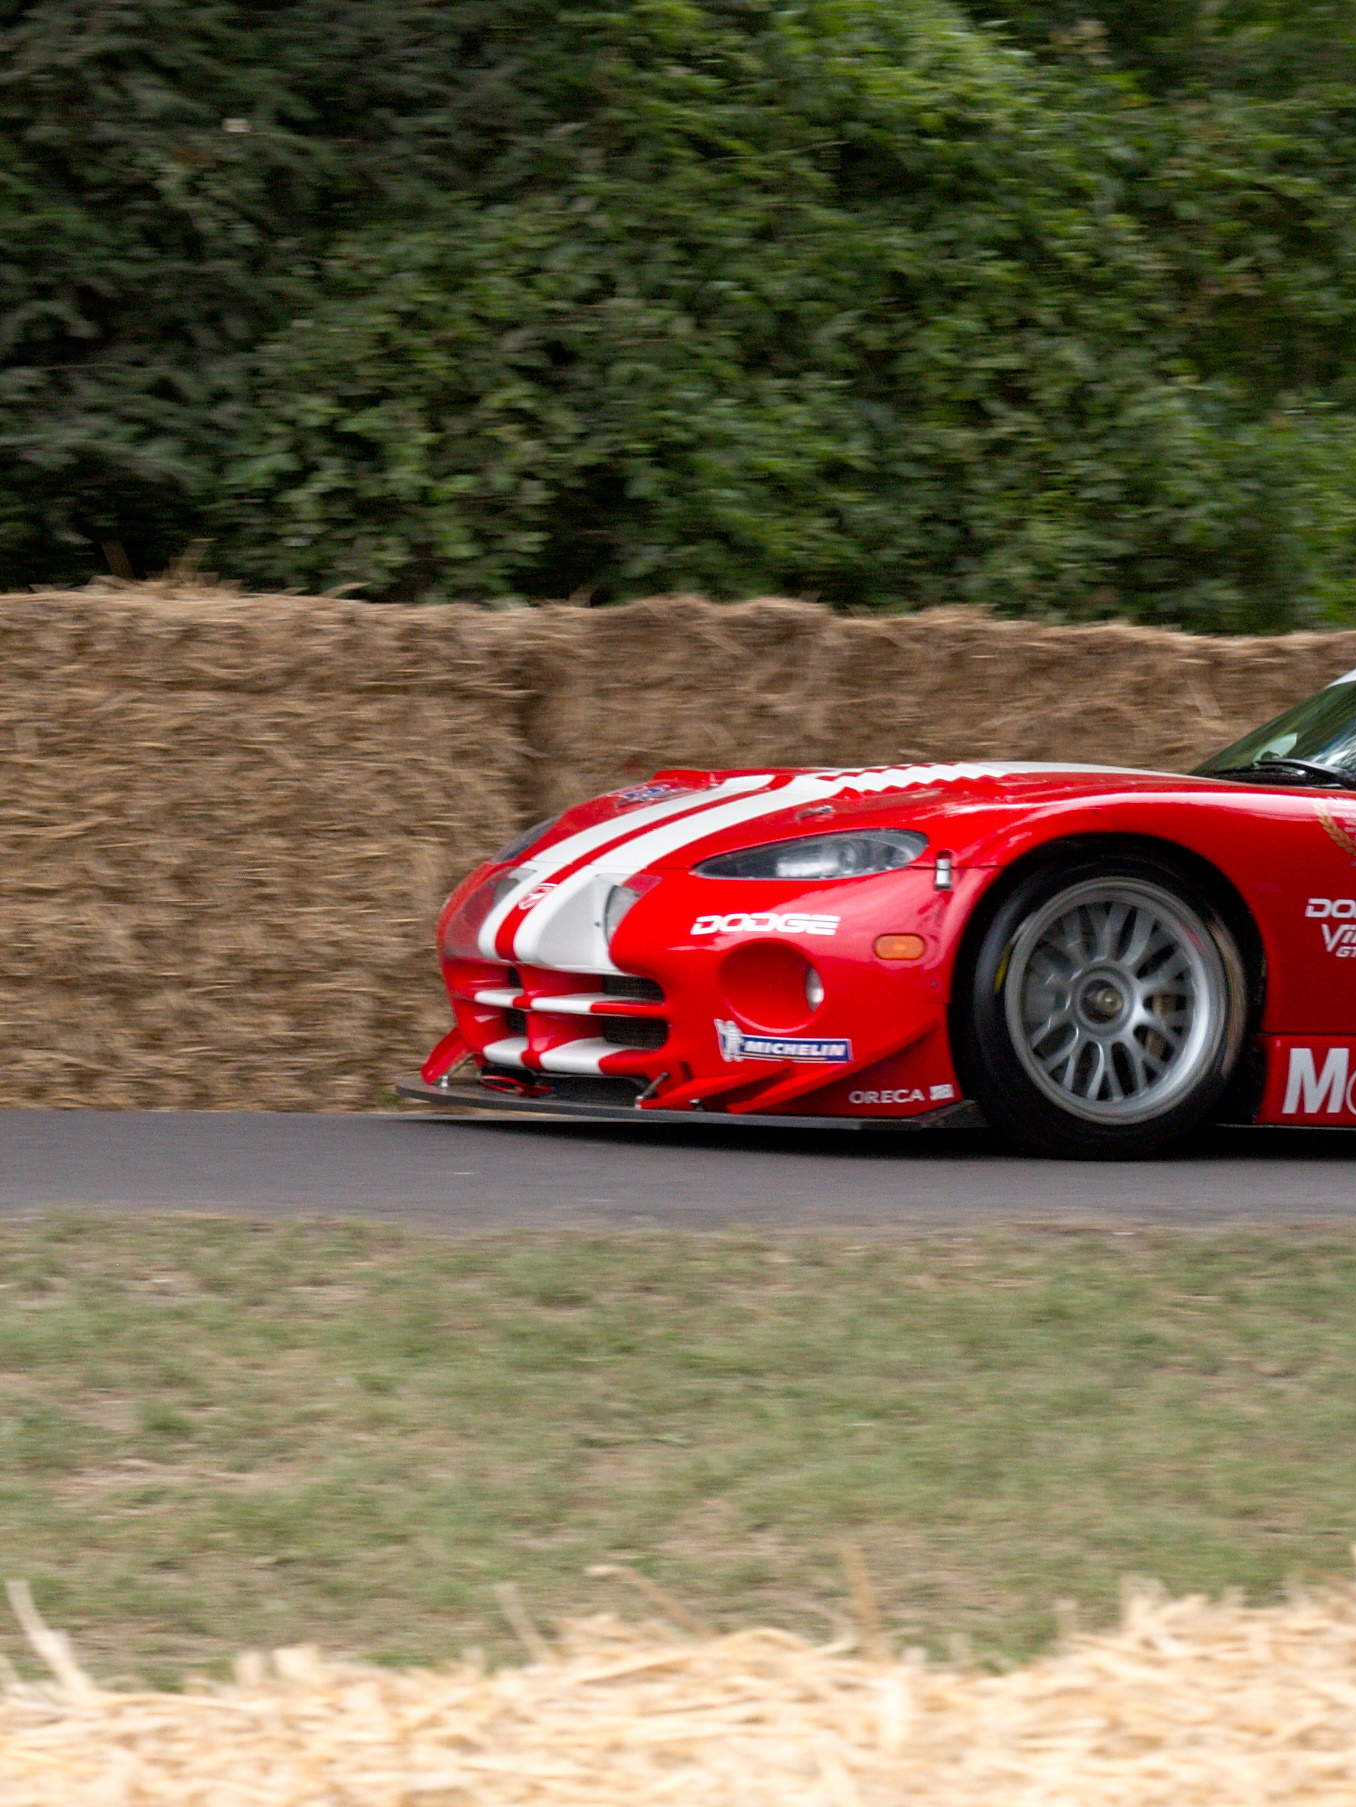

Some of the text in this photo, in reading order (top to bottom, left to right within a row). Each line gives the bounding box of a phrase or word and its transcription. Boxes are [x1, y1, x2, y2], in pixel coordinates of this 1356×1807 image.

[690, 912, 841, 936] DODGE
[743, 1040, 847, 1056] MICHELIN
[849, 1088, 925, 1104] ORECA
